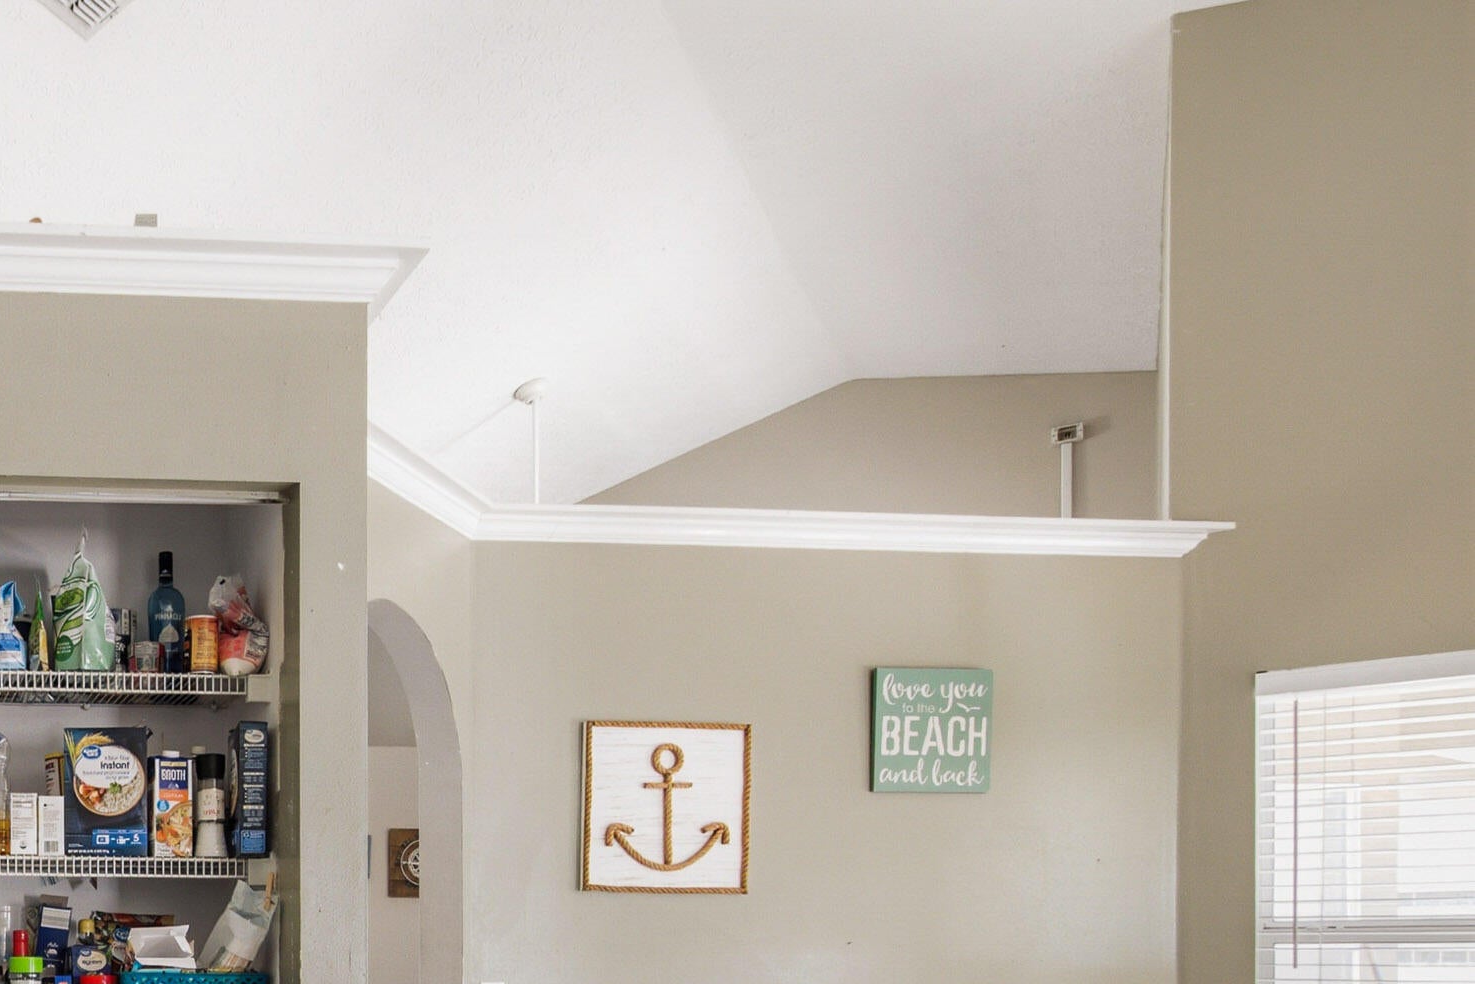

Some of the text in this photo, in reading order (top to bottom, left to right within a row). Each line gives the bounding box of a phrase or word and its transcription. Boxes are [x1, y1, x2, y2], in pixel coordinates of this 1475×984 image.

[883, 673, 988, 713] love you
[902, 703, 935, 713] to the
[880, 715, 988, 757] BEACH
[161, 769, 186, 781] BROTH
[879, 757, 985, 787] and back
